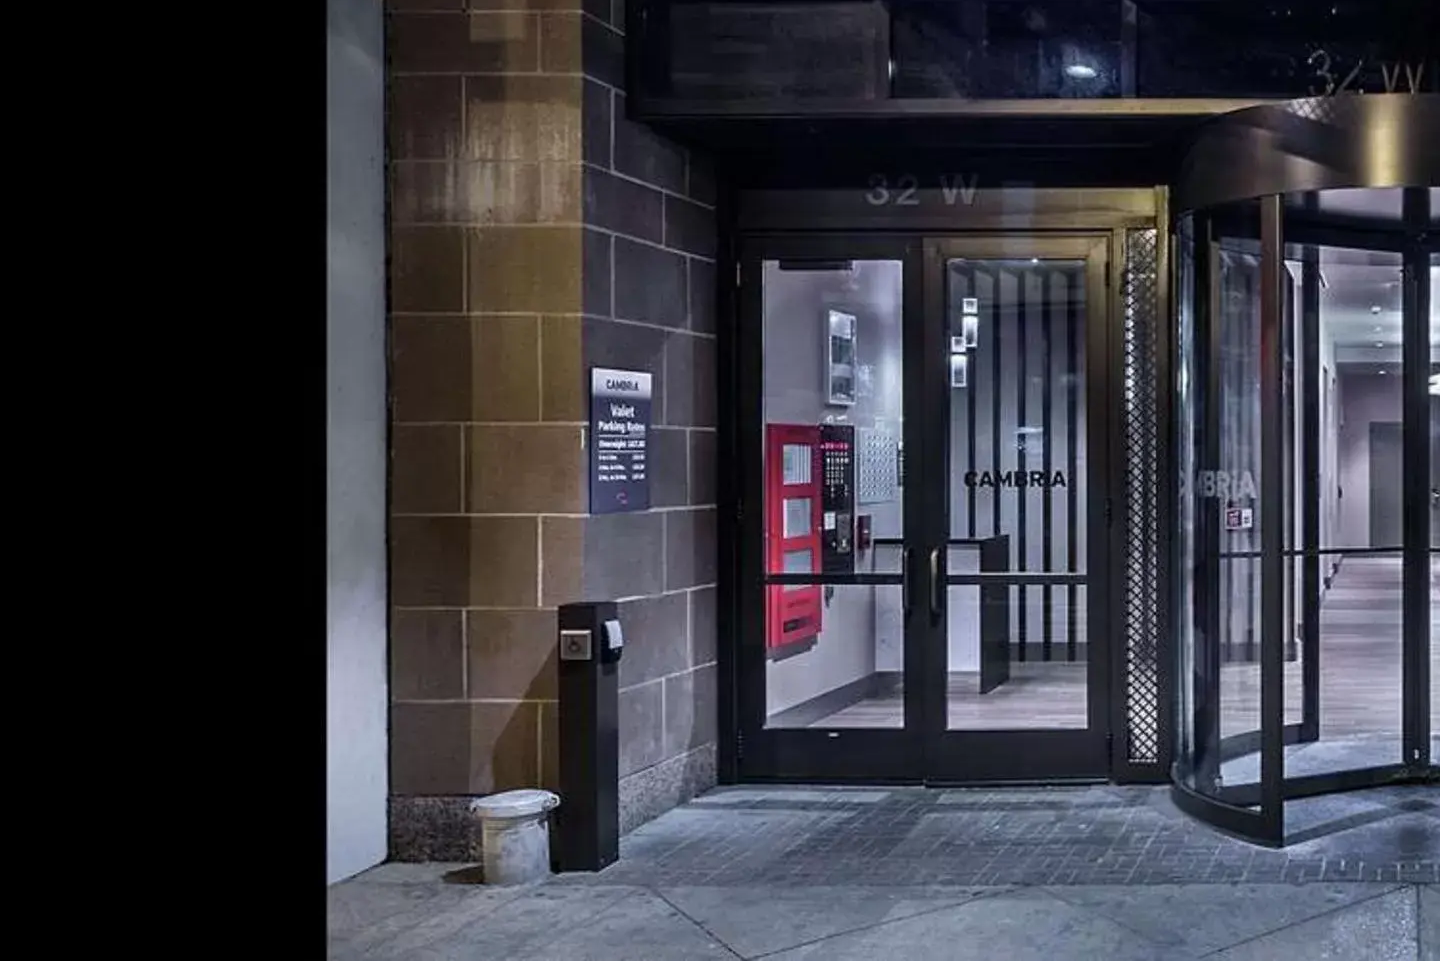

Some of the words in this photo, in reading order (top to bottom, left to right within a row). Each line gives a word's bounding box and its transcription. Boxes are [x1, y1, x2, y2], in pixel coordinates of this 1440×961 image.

[865, 172, 920, 205] 32
[939, 173, 979, 205] W
[610, 403, 636, 418] Valet
[598, 421, 625, 433] Parking
